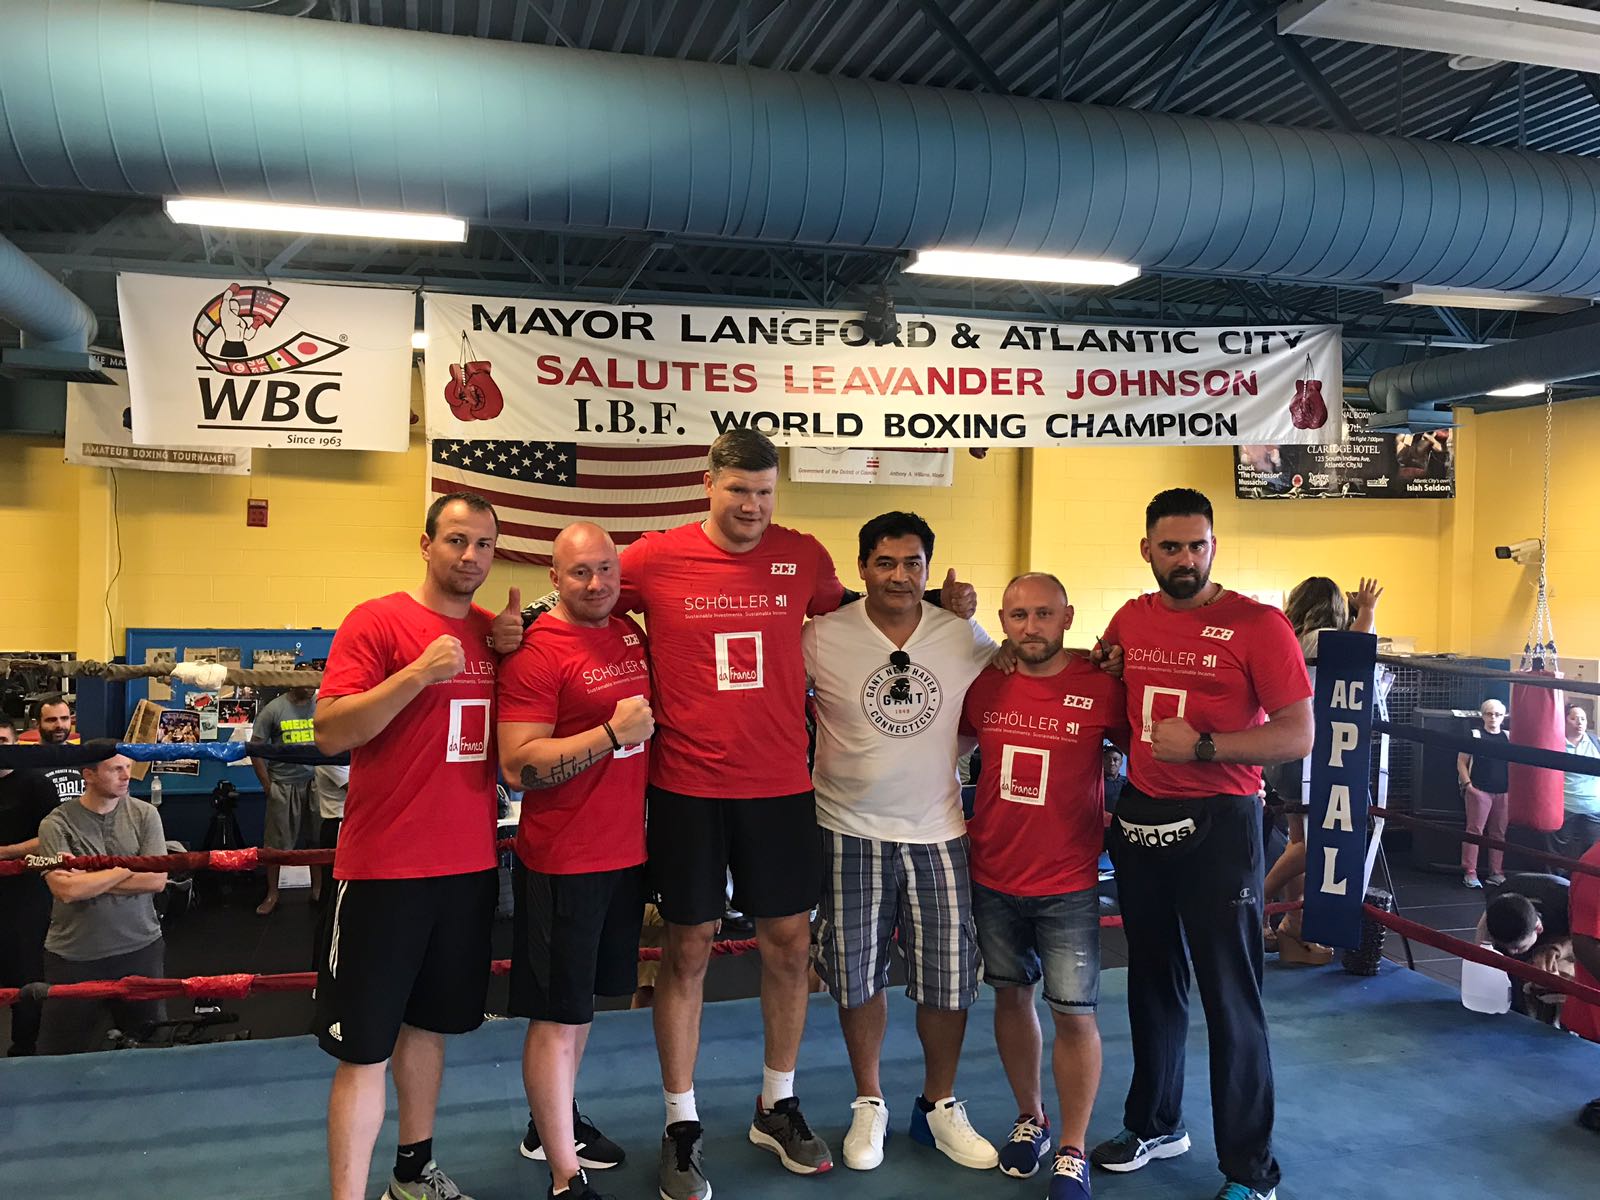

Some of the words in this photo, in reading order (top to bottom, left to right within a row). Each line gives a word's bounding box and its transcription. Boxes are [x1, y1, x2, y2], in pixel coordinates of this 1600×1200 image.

[471, 304, 655, 341] MAYOR
[950, 323, 980, 350] &
[999, 325, 1199, 354] ATLANTIC
[1217, 329, 1306, 355] CITY
[536, 355, 758, 394] SALUTES
[784, 364, 1045, 397] LEAVANDER
[1066, 368, 1259, 399] JOHNSON
[198, 377, 341, 425] WBC
[574, 398, 685, 435] I.B.F.
[710, 410, 863, 438] WORLD
[884, 413, 1025, 438] BOXING
[1045, 411, 1238, 438] CHAMPION
[287, 434, 316, 445] Since
[319, 437, 342, 447] 1963
[1307, 444, 1352, 454] CLARIDGE
[1353, 445, 1380, 454] HOTEL
[85, 445, 128, 457] AMATEUR
[133, 449, 168, 460] BOXING
[172, 451, 235, 464] TOURNAMENT
[684, 594, 769, 611] SCHÖLLER
[1127, 647, 1197, 666] SCHÖLLER
[463, 660, 495, 676] LLER
[582, 660, 642, 686] SCHÖLLER
[730, 666, 757, 681] Franco
[866, 673, 884, 698] GANT
[912, 668, 938, 694] HAVEN
[1330, 680, 1364, 711] AC
[870, 706, 935, 733] CONNECTICUT
[982, 711, 1059, 732] SCHÖLLER
[448, 735, 459, 751] da
[460, 736, 483, 751] Franco
[1011, 778, 1039, 796] Franco
